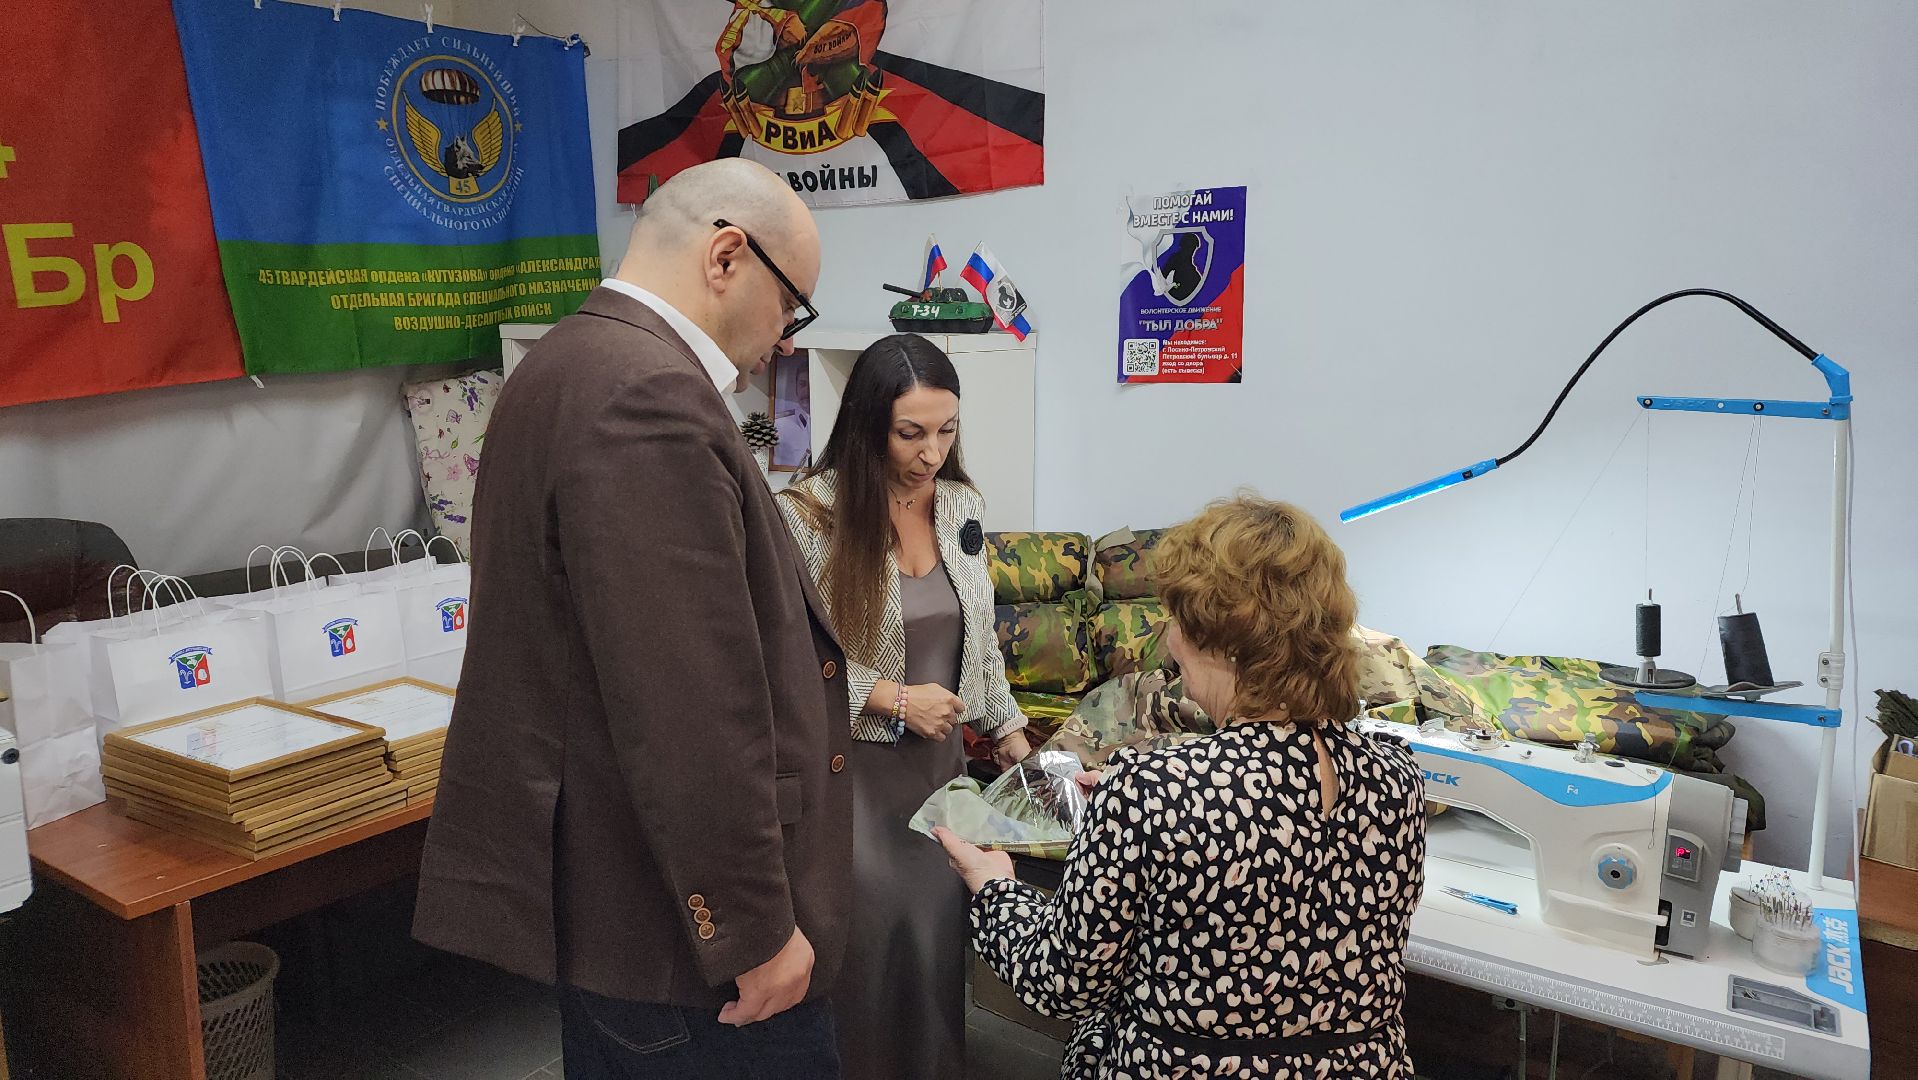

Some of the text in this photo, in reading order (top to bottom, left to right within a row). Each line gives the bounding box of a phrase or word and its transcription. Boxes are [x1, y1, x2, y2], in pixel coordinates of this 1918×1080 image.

[375, 37, 431, 111] ПОБЕЖДАЕТ
[455, 180, 472, 194] 45
[787, 163, 878, 193] ВОЙНЫ
[384, 165, 480, 231] СПЕЦИАЛЬНОГО
[1153, 190, 1213, 210] ПОМОГАЙ
[1133, 208, 1234, 228] ВМЕСТЕ С НАМИ!
[2, 222, 155, 324] Бр
[258, 269, 274, 284] 45
[275, 268, 369, 288] ГВАРДЕЙСКАЯ
[370, 270, 421, 285] ордена
[330, 292, 406, 310] ОТДЕЛЬНАЯ
[407, 291, 462, 309] БРИГАДА
[463, 281, 527, 306] СПЕЦИАЛЬНОГО
[513, 301, 553, 318] ВОЙСК
[911, 304, 941, 318] Т-34
[1139, 318, 1223, 332] "ТЫЛ ДОБРА"
